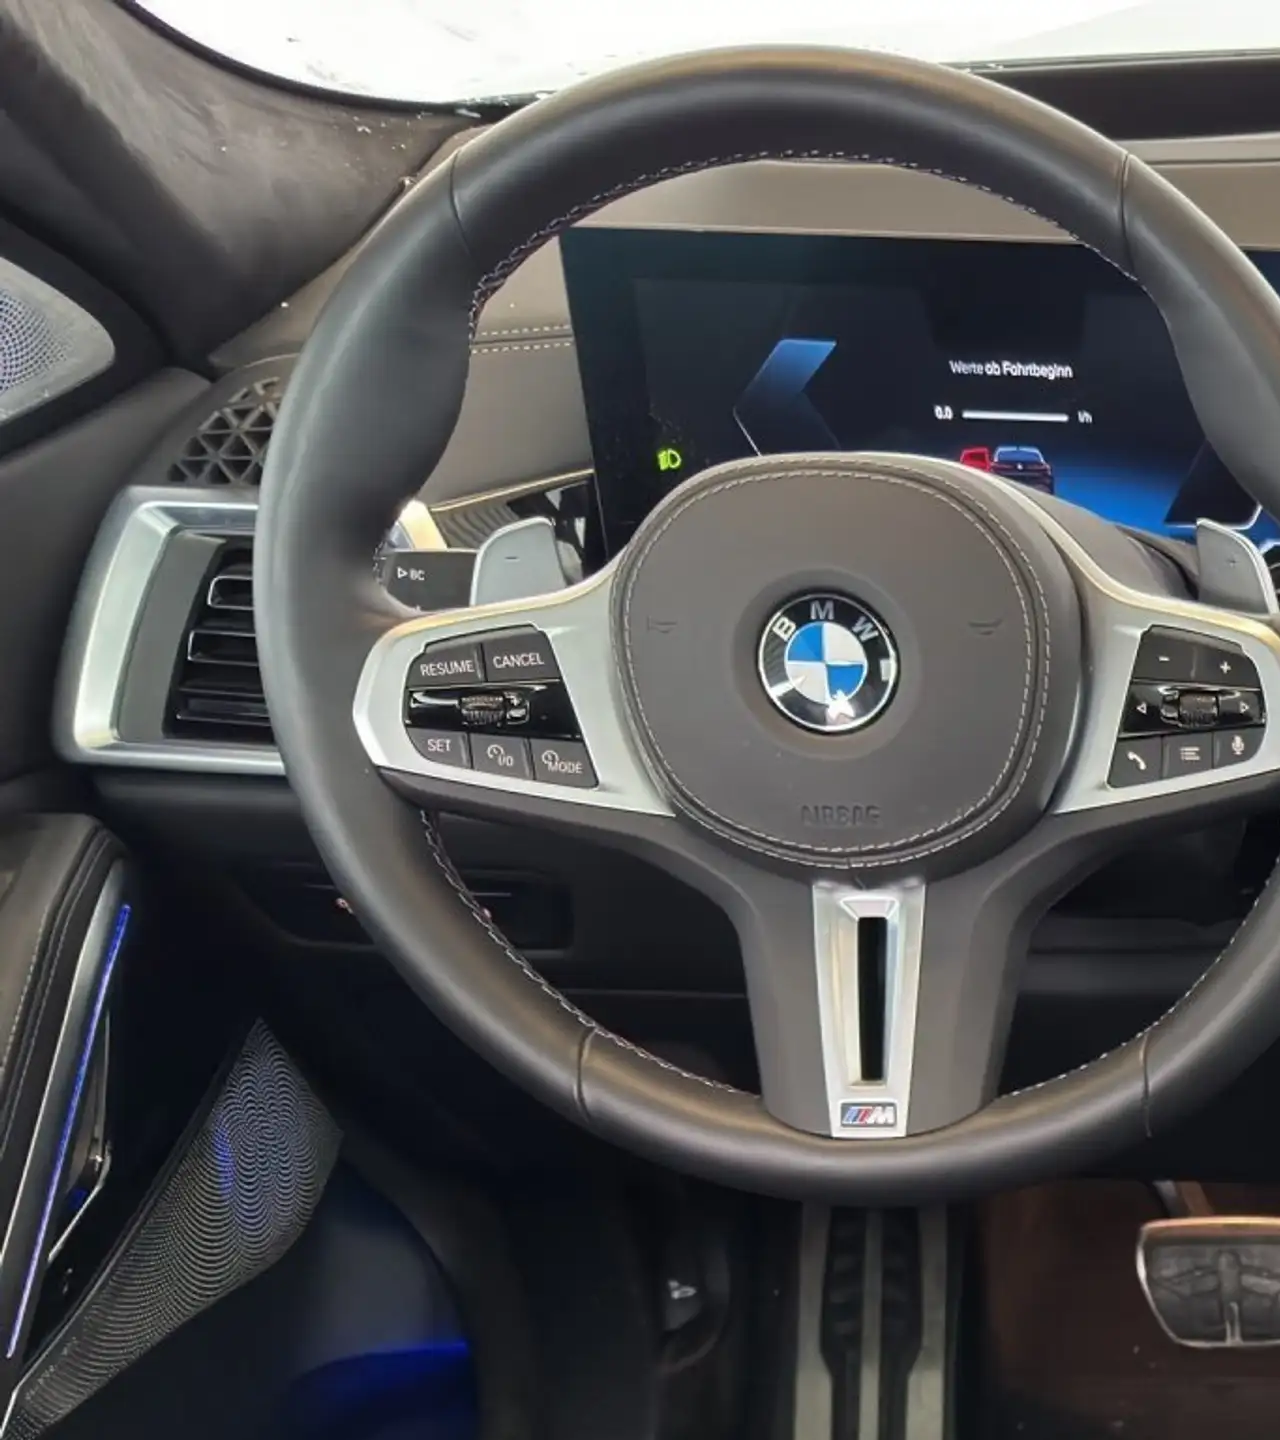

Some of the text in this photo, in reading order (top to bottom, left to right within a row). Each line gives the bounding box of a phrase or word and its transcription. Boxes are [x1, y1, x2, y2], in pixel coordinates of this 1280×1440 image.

[949, 360, 984, 375] Werte
[1001, 360, 1074, 381] Fahrtbeginn
[410, 569, 425, 581] BC
[772, 600, 880, 643] BMW
[420, 658, 475, 677] RESUME
[492, 652, 545, 669] CANCEL
[427, 739, 451, 751] SET
[548, 760, 583, 774] MODE
